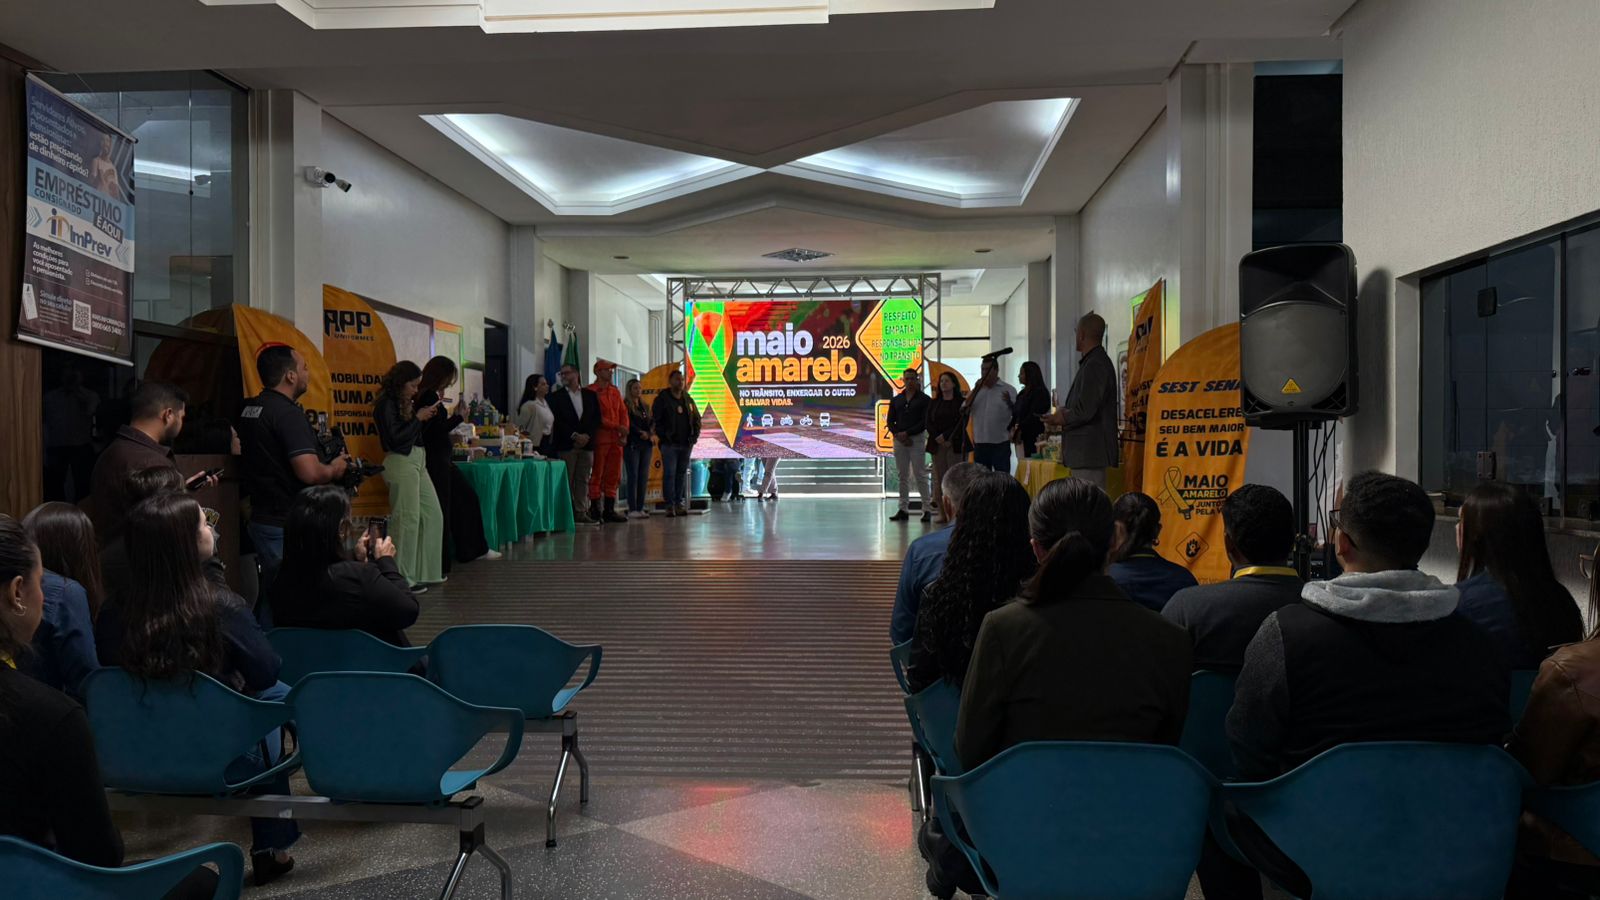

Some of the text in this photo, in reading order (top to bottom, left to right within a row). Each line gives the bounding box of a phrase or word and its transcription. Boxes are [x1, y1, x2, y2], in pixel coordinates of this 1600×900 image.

[29, 141, 39, 153] de
[39, 146, 66, 167] dinheiro
[30, 132, 83, 164] estão precisando
[34, 188, 82, 215] CONSIGNADO
[35, 167, 122, 223] EMPRÉSTIMO
[102, 220, 121, 241] AQUI
[70, 225, 112, 257] ImPrev
[33, 241, 63, 258] As melhores
[45, 262, 73, 276] aposentado
[58, 258, 69, 267] para
[883, 310, 917, 322] RESPEITO
[884, 324, 915, 335] EMPATIA
[736, 322, 851, 355] maio 2026
[736, 350, 858, 382] amarelo
[739, 388, 857, 398] NO TRÂNSITO, ENXERGAR O OUTRO
[1158, 381, 1200, 394] SEST
[739, 397, 793, 406] É SALVAR VIDAS.
[1159, 423, 1245, 434] SEU BEM MAIOR
[1156, 438, 1243, 457] É A VIDA
[1184, 474, 1229, 488] MAIO
[1182, 489, 1227, 498] AMARELO
